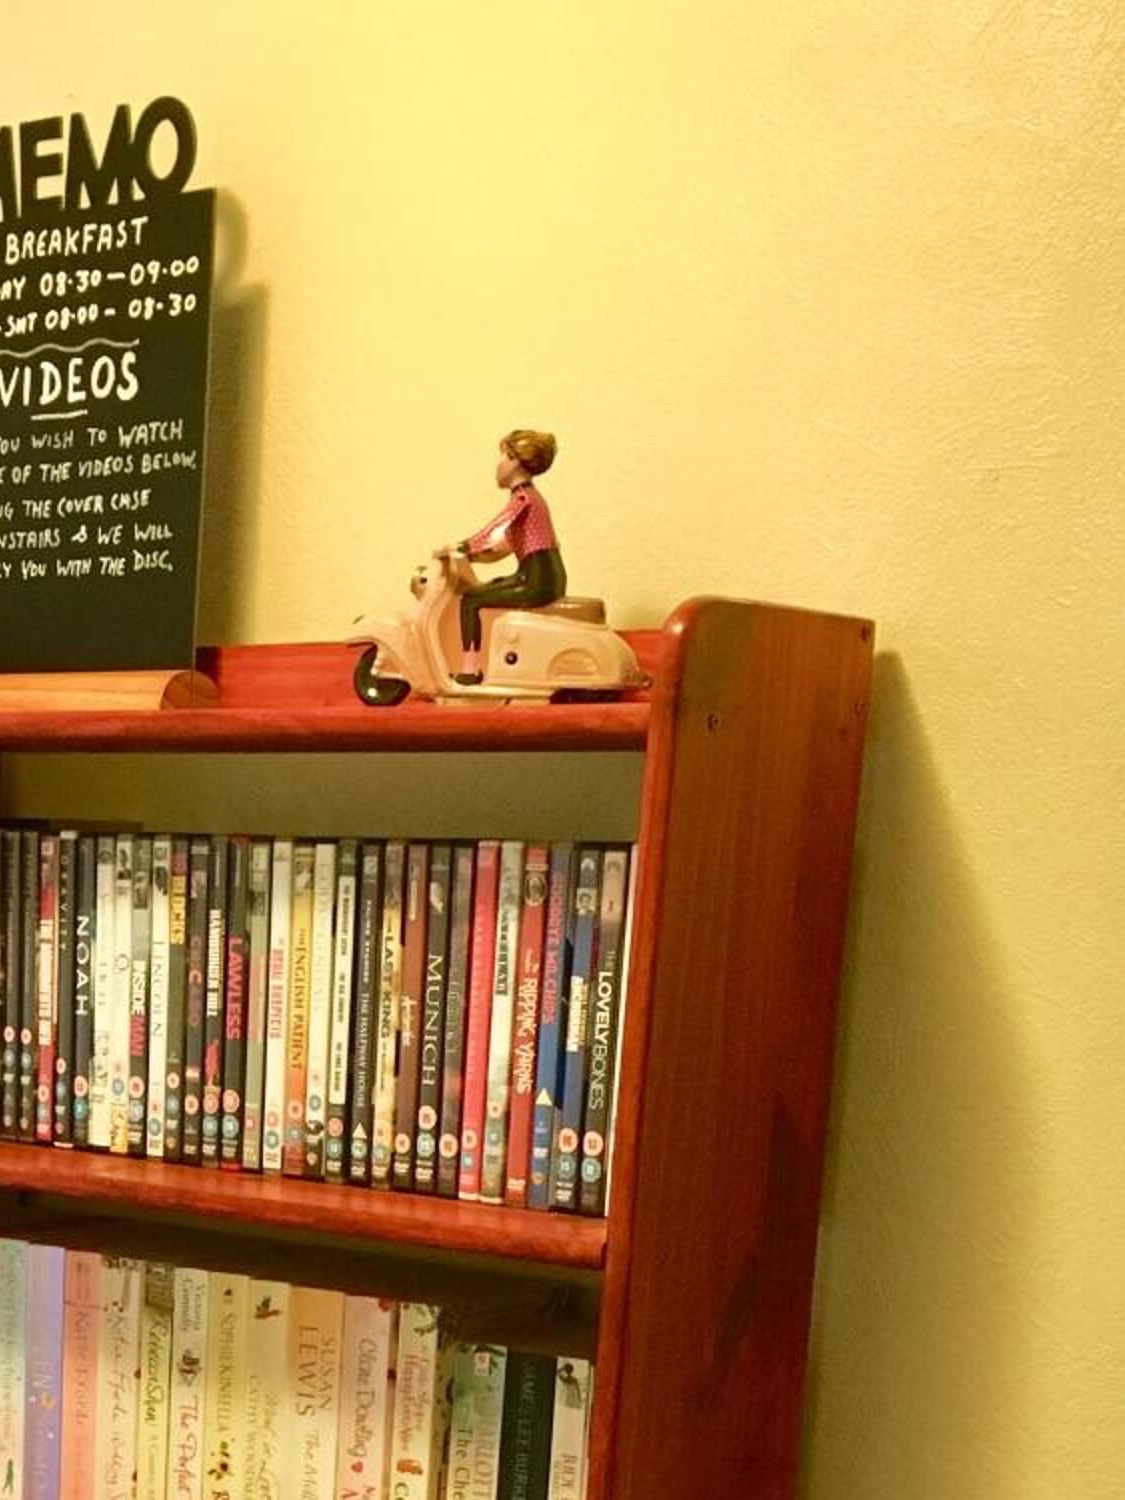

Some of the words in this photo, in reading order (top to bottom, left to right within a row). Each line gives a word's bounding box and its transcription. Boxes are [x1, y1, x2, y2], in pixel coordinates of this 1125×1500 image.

[5, 216, 149, 264] BREAKFAST
[32, 429, 74, 449] WISH
[87, 427, 107, 446] TO
[119, 418, 183, 448] WATCH
[12, 465, 32, 484] OF
[39, 461, 72, 482] THE
[79, 454, 133, 477] VIDEOS
[22, 500, 51, 518] THE
[57, 495, 104, 518] COVER
[111, 489, 151, 511] CASE
[98, 525, 123, 544] WE
[134, 523, 173, 541] WILL
[22, 561, 46, 580] YOU
[57, 559, 92, 577] WITH
[99, 557, 126, 576] THE
[170, 876, 186, 945] BLOCKS
[75, 915, 91, 1016] NOAH
[226, 934, 244, 1041] LAWLESS
[292, 946, 309, 1010] ENGLISH
[381, 935, 395, 985] LAST
[149, 941, 167, 1037] LINCOLN
[379, 990, 394, 1039] KING
[516, 977, 537, 1037] RIPPING
[595, 971, 614, 1045] LOVELY
[290, 1013, 305, 1071] PATIENT
[421, 952, 443, 1085] MUNICH
[513, 1041, 535, 1095] YARNS
[589, 1045, 608, 1110] BONES
[220, 1311, 239, 1366] SOPHIE
[295, 1324, 321, 1416] LEWIS
[318, 1332, 337, 1410] SUSAN
[178, 1394, 199, 1432] The
[218, 1364, 237, 1433] KINSELLA
[246, 1375, 263, 1424] CATHY
[176, 1436, 199, 1493] Perfect
[304, 1430, 322, 1464] The
[455, 1427, 474, 1460] The
